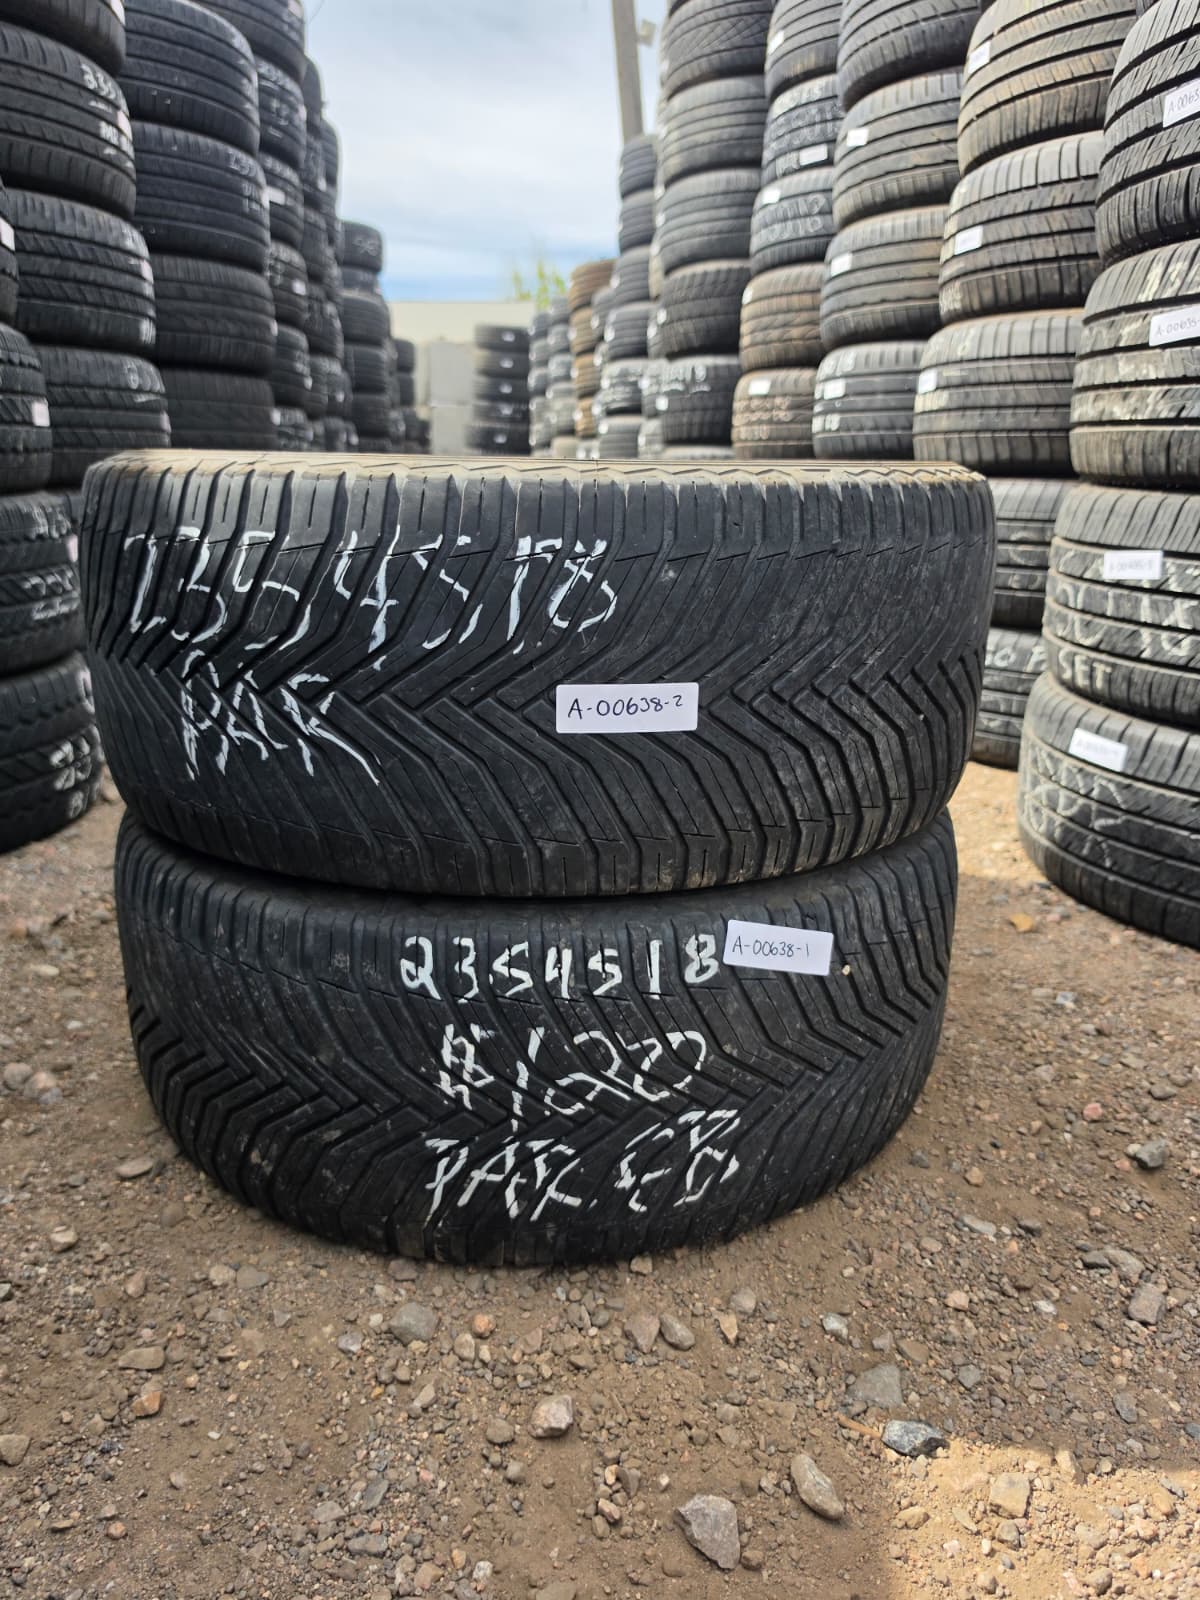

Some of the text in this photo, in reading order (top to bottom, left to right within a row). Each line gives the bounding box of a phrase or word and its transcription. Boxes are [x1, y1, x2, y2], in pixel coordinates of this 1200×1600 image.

[1058, 648, 1112, 690] SET
[567, 694, 683, 719] A-00638-2
[732, 935, 811, 958] A-00638-1
